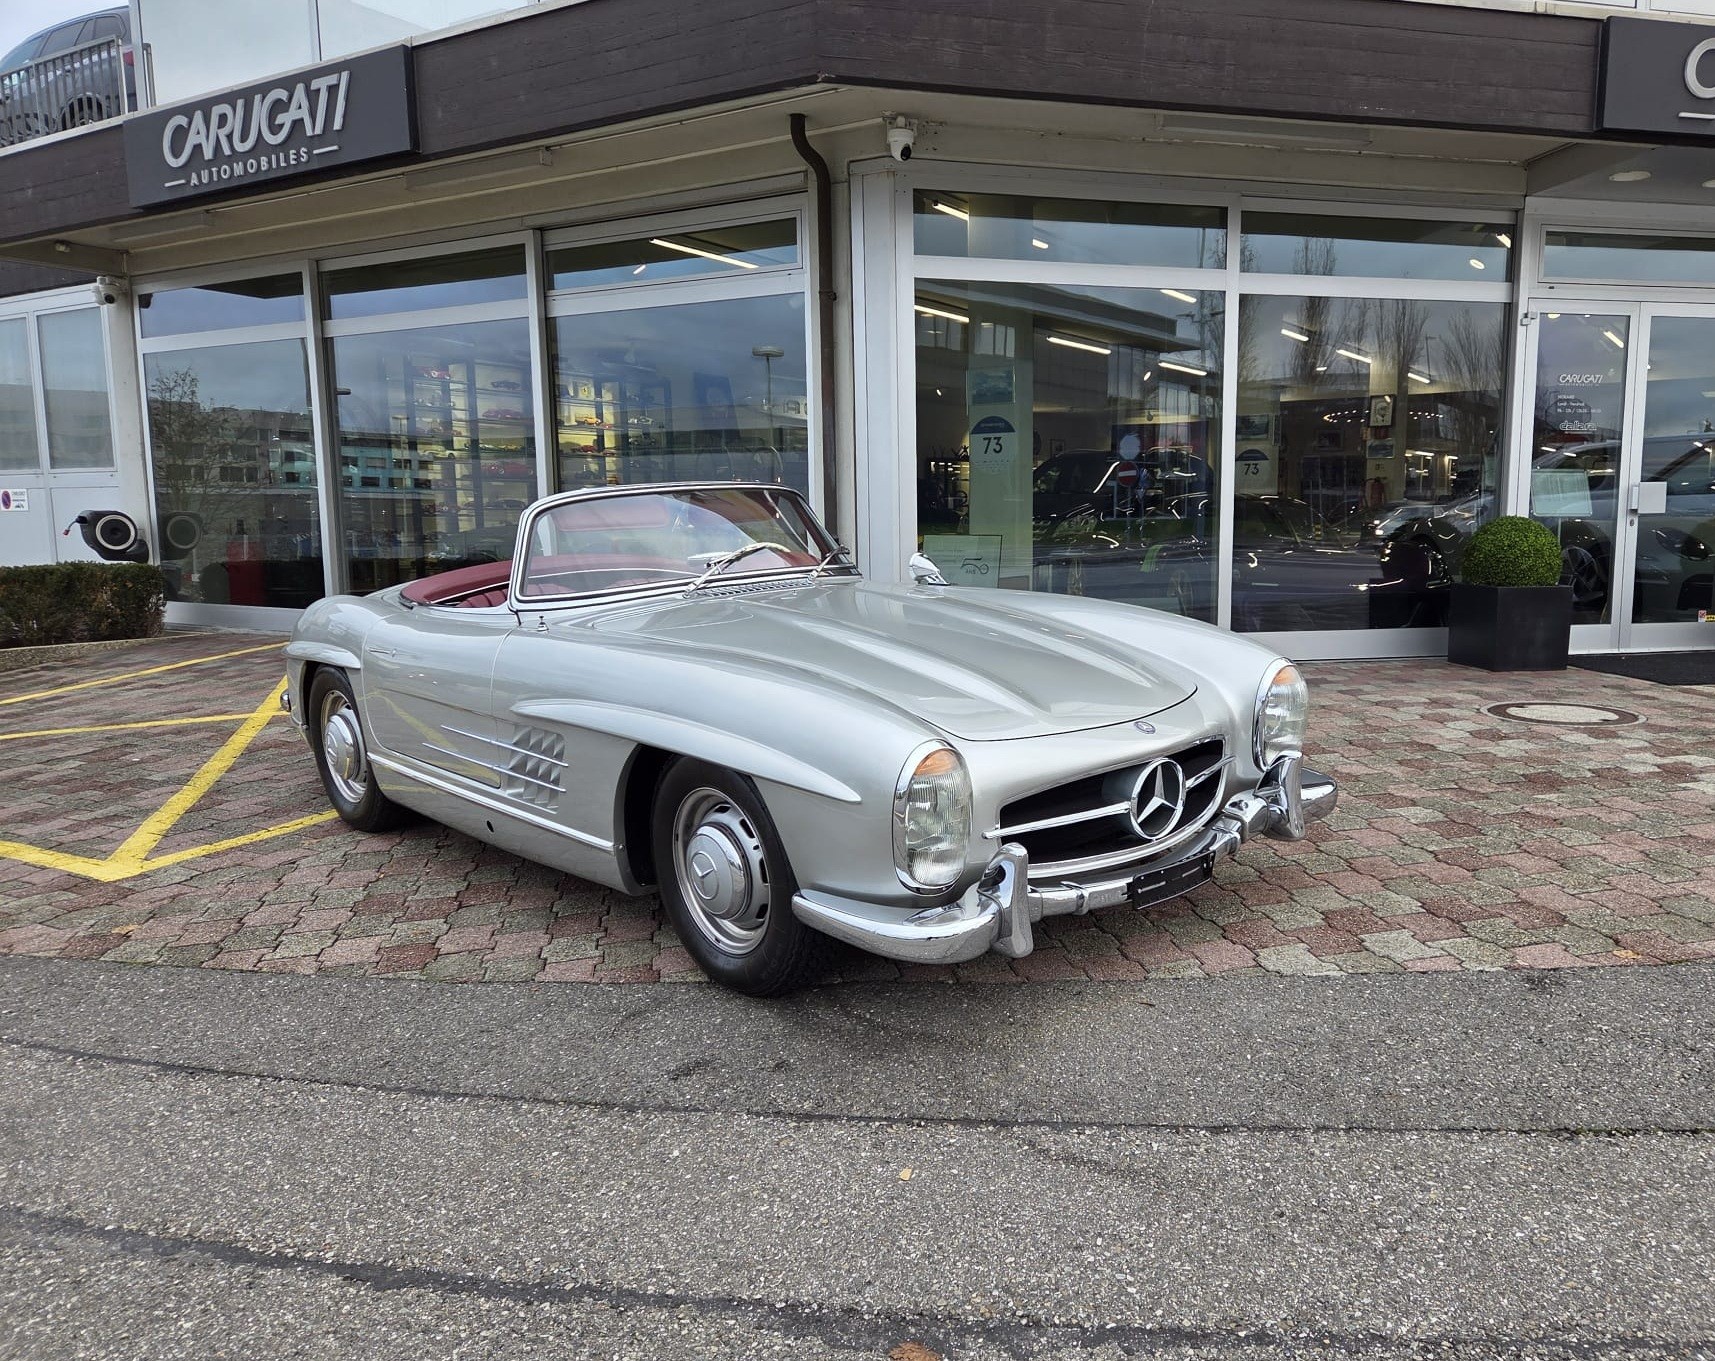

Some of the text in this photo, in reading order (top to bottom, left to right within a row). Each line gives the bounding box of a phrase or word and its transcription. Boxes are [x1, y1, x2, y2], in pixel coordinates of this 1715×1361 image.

[163, 70, 351, 168] CARUGATI
[190, 147, 309, 187] AUTOMOBILES
[1560, 374, 1603, 383] CARUGATI
[982, 436, 1003, 454] 73
[1244, 463, 1260, 476] 73
